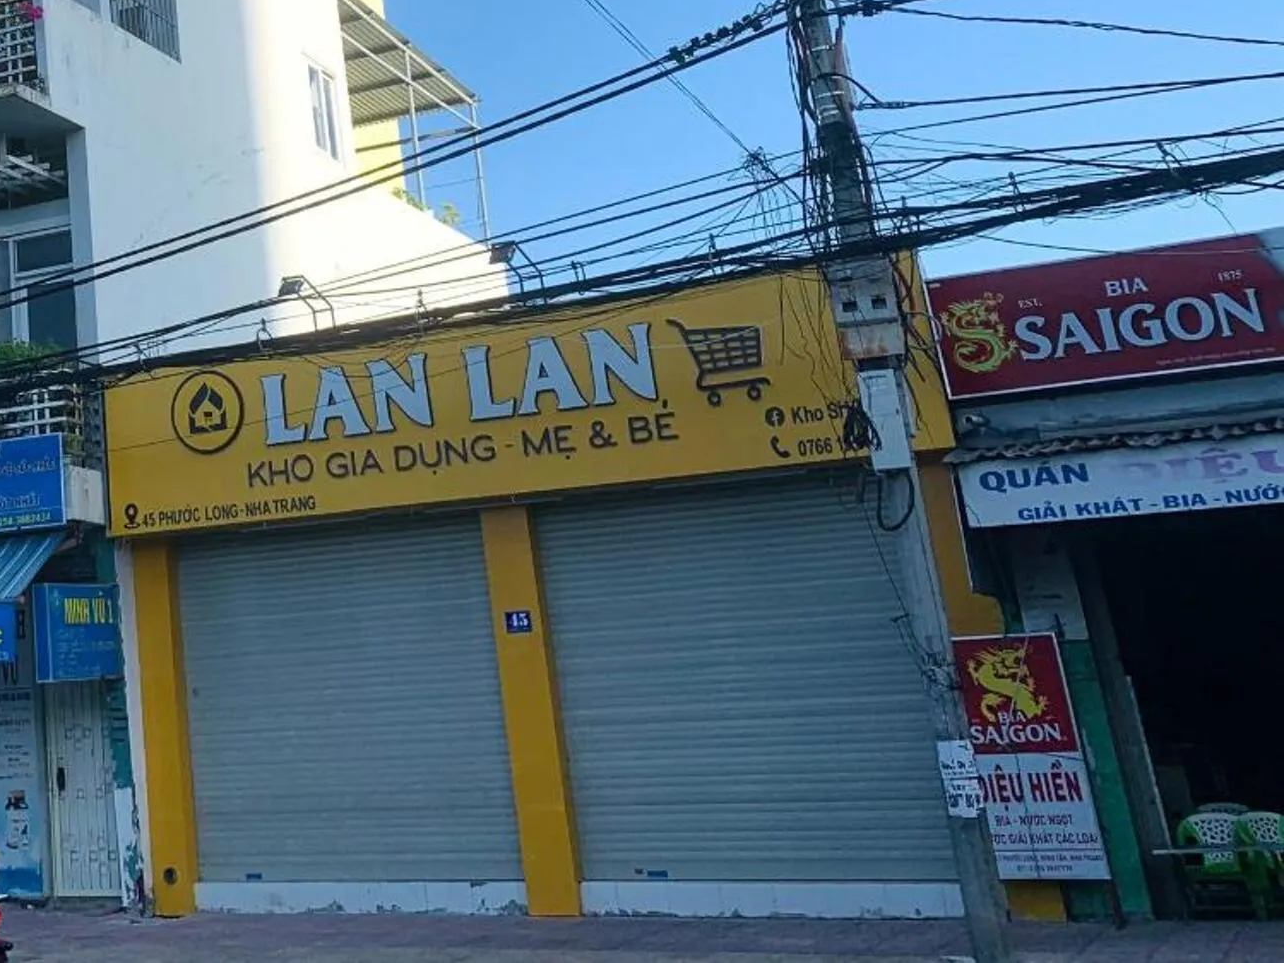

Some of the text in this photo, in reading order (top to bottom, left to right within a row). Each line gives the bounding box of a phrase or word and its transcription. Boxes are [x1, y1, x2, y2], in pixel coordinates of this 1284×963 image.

[1104, 277, 1148, 298] BIA
[1018, 297, 1043, 309] EST.
[1015, 287, 1265, 362] SAIGON
[260, 322, 660, 447] LAN LAN
[791, 406, 824, 425] Kho
[247, 453, 315, 489] KHO
[325, 449, 385, 478] GIA
[394, 434, 497, 476] DỤNG
[521, 424, 577, 460] MẸ
[589, 421, 618, 449] &
[628, 397, 680, 443] BÉ
[798, 437, 833, 457] 0766
[979, 460, 1090, 493] QUÁN
[142, 514, 156, 528] 45
[158, 504, 201, 526] PHƯỚC
[272, 495, 316, 514] TRANG
[1018, 499, 1067, 521] GIẢI
[1076, 494, 1144, 517] KHÁT
[1162, 492, 1208, 510] BIA
[1225, 483, 1284, 504] NƯỚ
[64, 598, 90, 624] MINH
[998, 711, 1026, 725] BIA
[969, 722, 1062, 745] SAIGON
[1028, 759, 1084, 804] HIỀN
